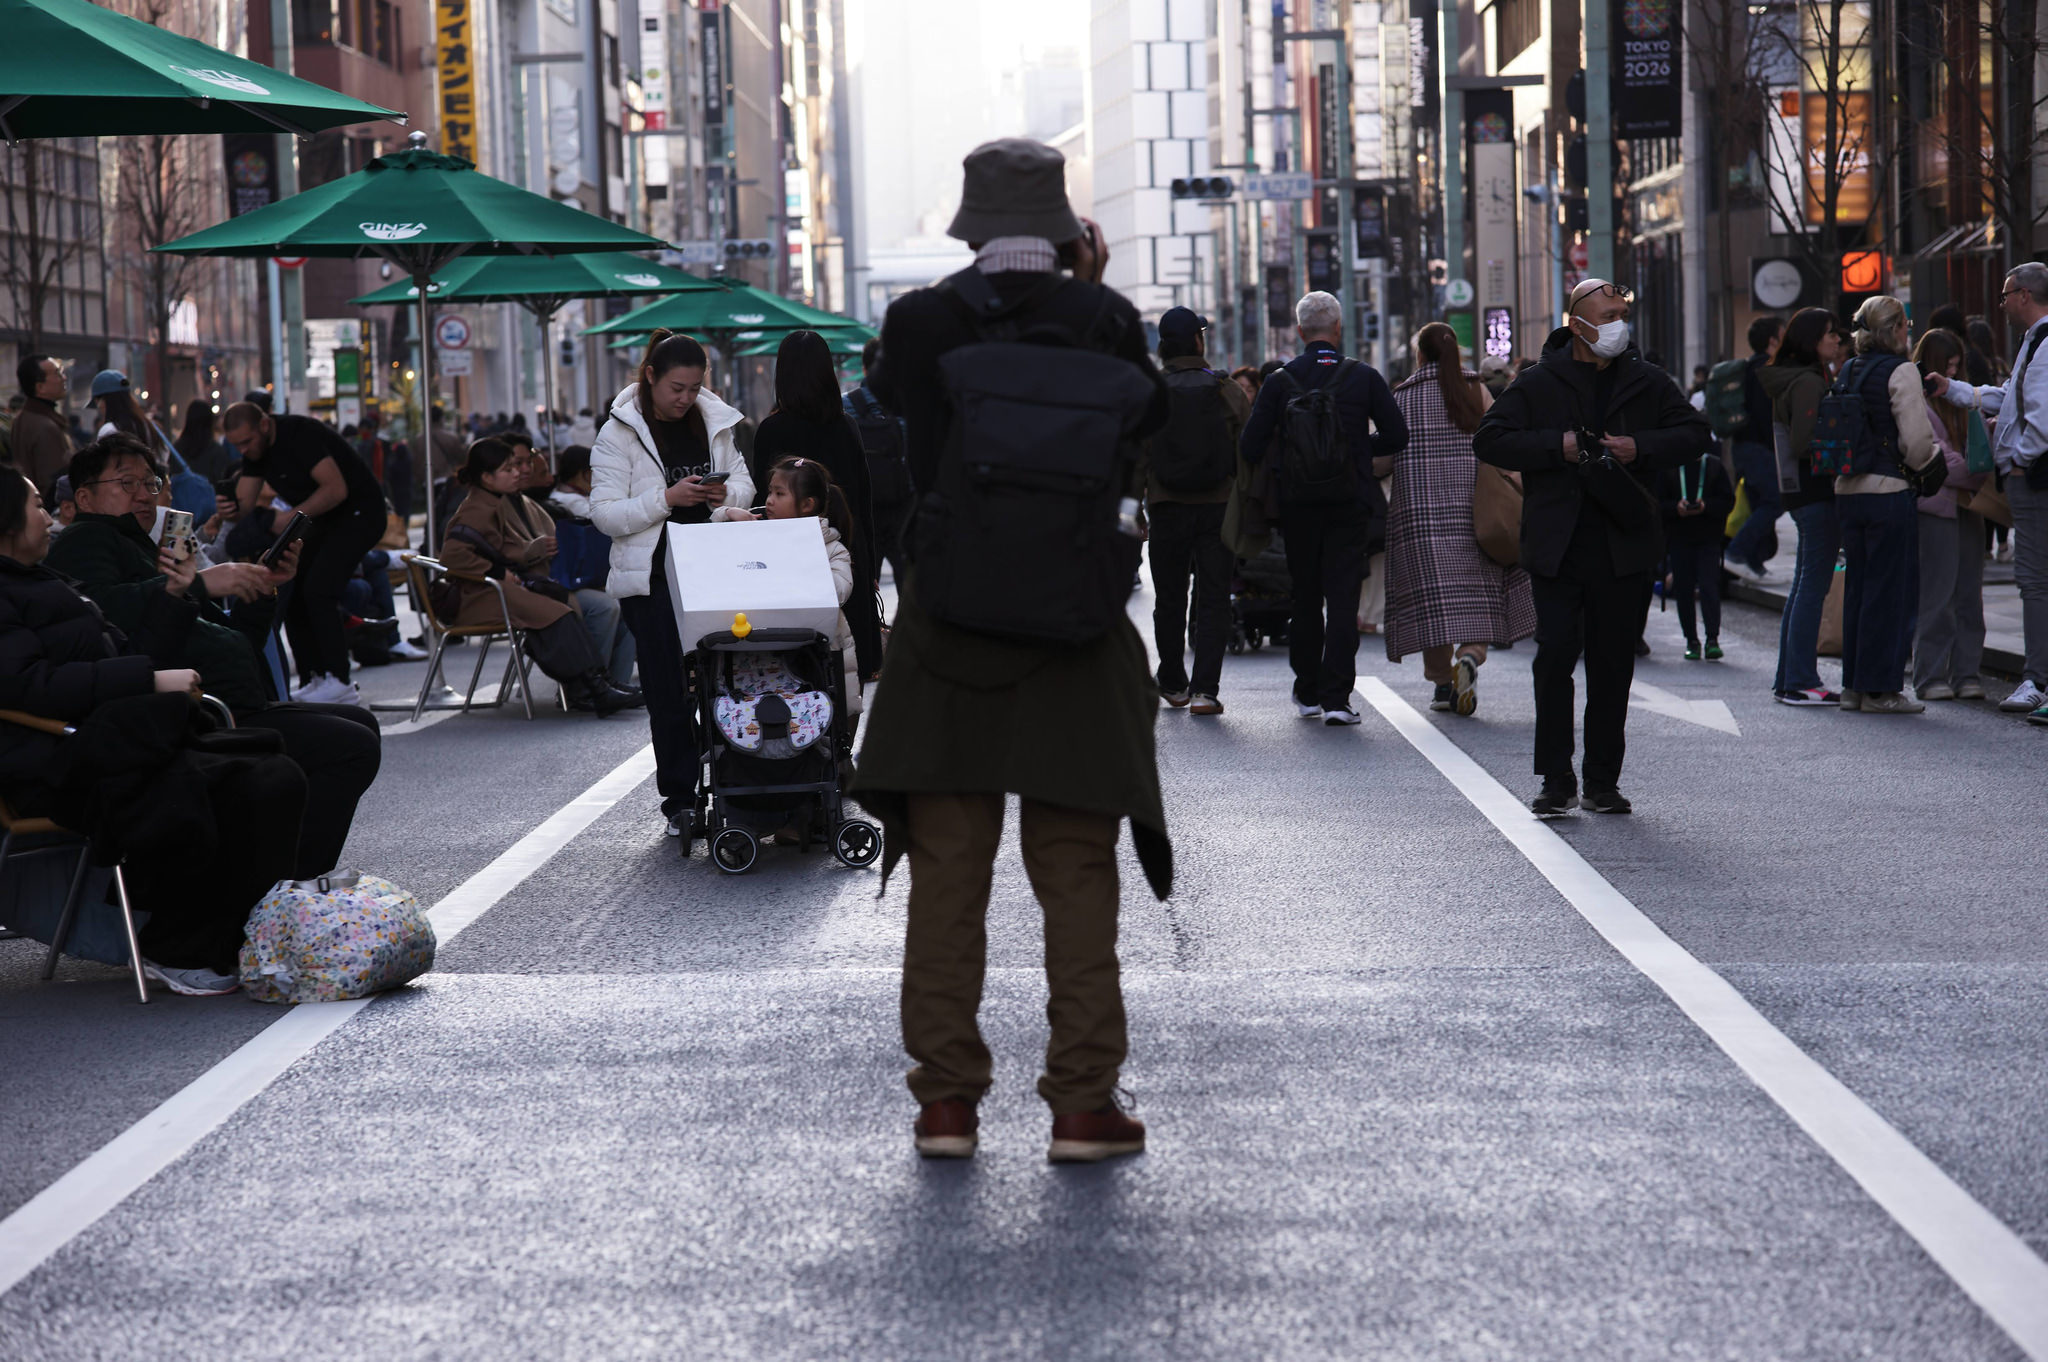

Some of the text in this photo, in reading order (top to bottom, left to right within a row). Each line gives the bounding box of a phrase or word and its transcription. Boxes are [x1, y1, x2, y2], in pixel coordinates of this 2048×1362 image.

[1624, 40, 1671, 53] TOKYO
[1624, 61, 1671, 77] 2026
[358, 222, 428, 232] GINZA
